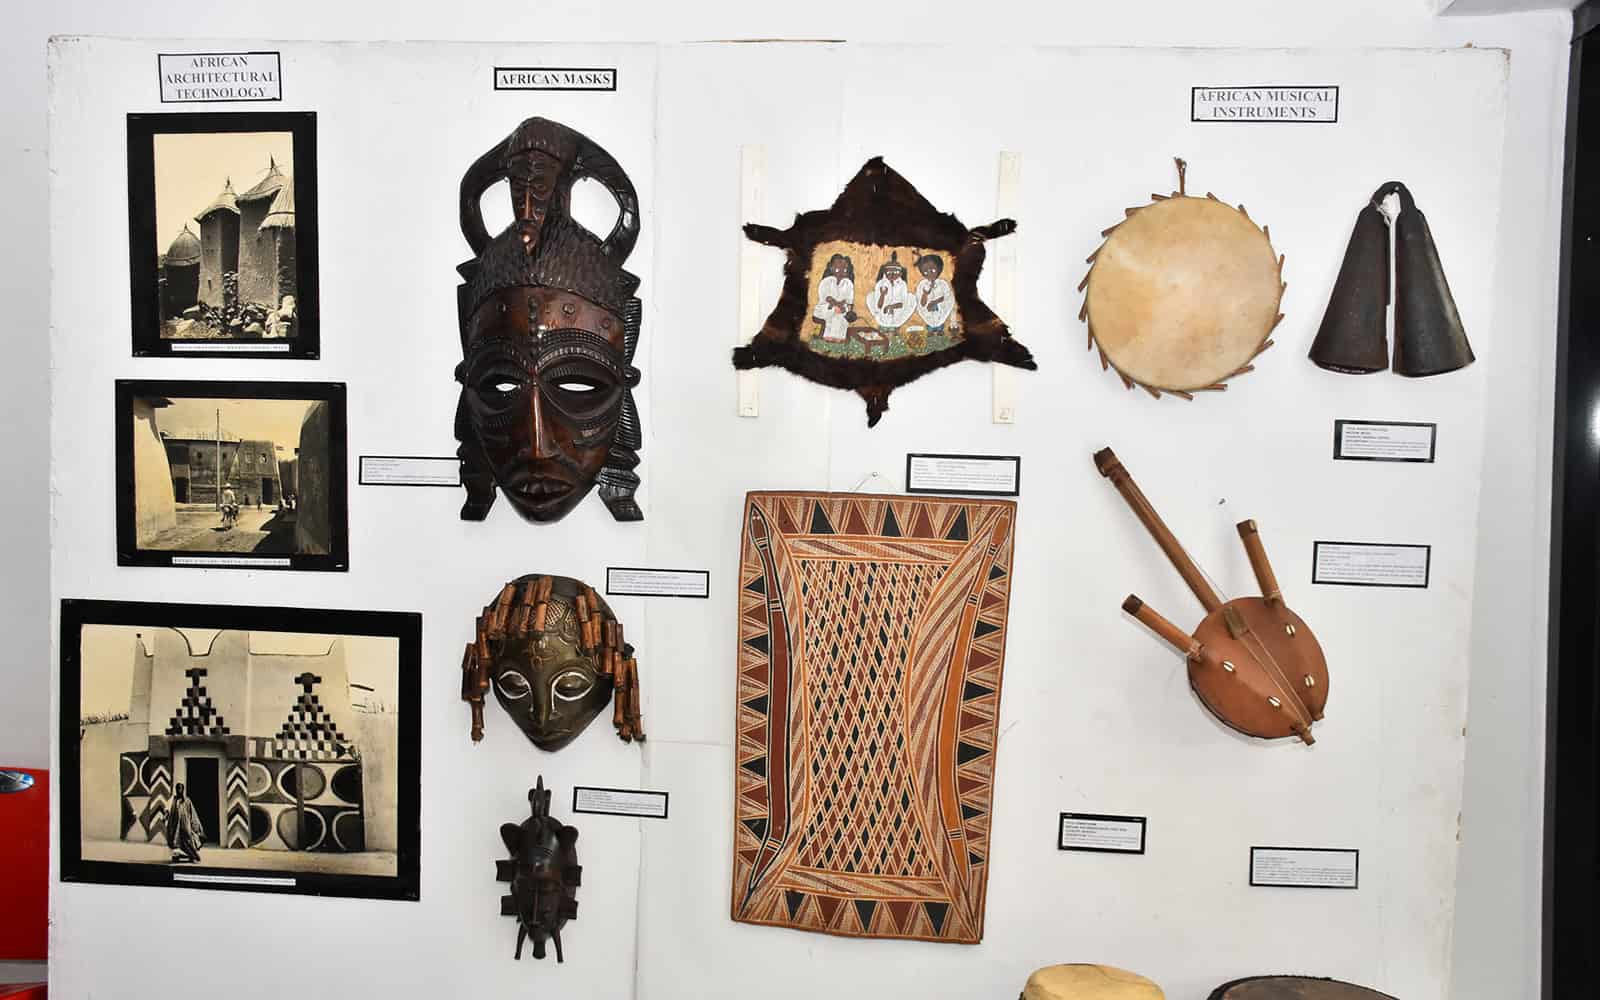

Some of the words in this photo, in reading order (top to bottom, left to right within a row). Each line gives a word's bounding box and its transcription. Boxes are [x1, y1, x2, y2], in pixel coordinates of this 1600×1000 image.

[191, 56, 248, 68] AFRICAN
[166, 71, 276, 84] ARCHITECTURAL
[501, 73, 560, 84] AFRICAN
[565, 73, 611, 84] MASKS
[176, 87, 266, 99] TECHNOLOGY
[1199, 90, 1262, 102] AFRICAN
[1267, 90, 1333, 102] MUSICAL
[1213, 106, 1317, 118] INSTRUMENTS
